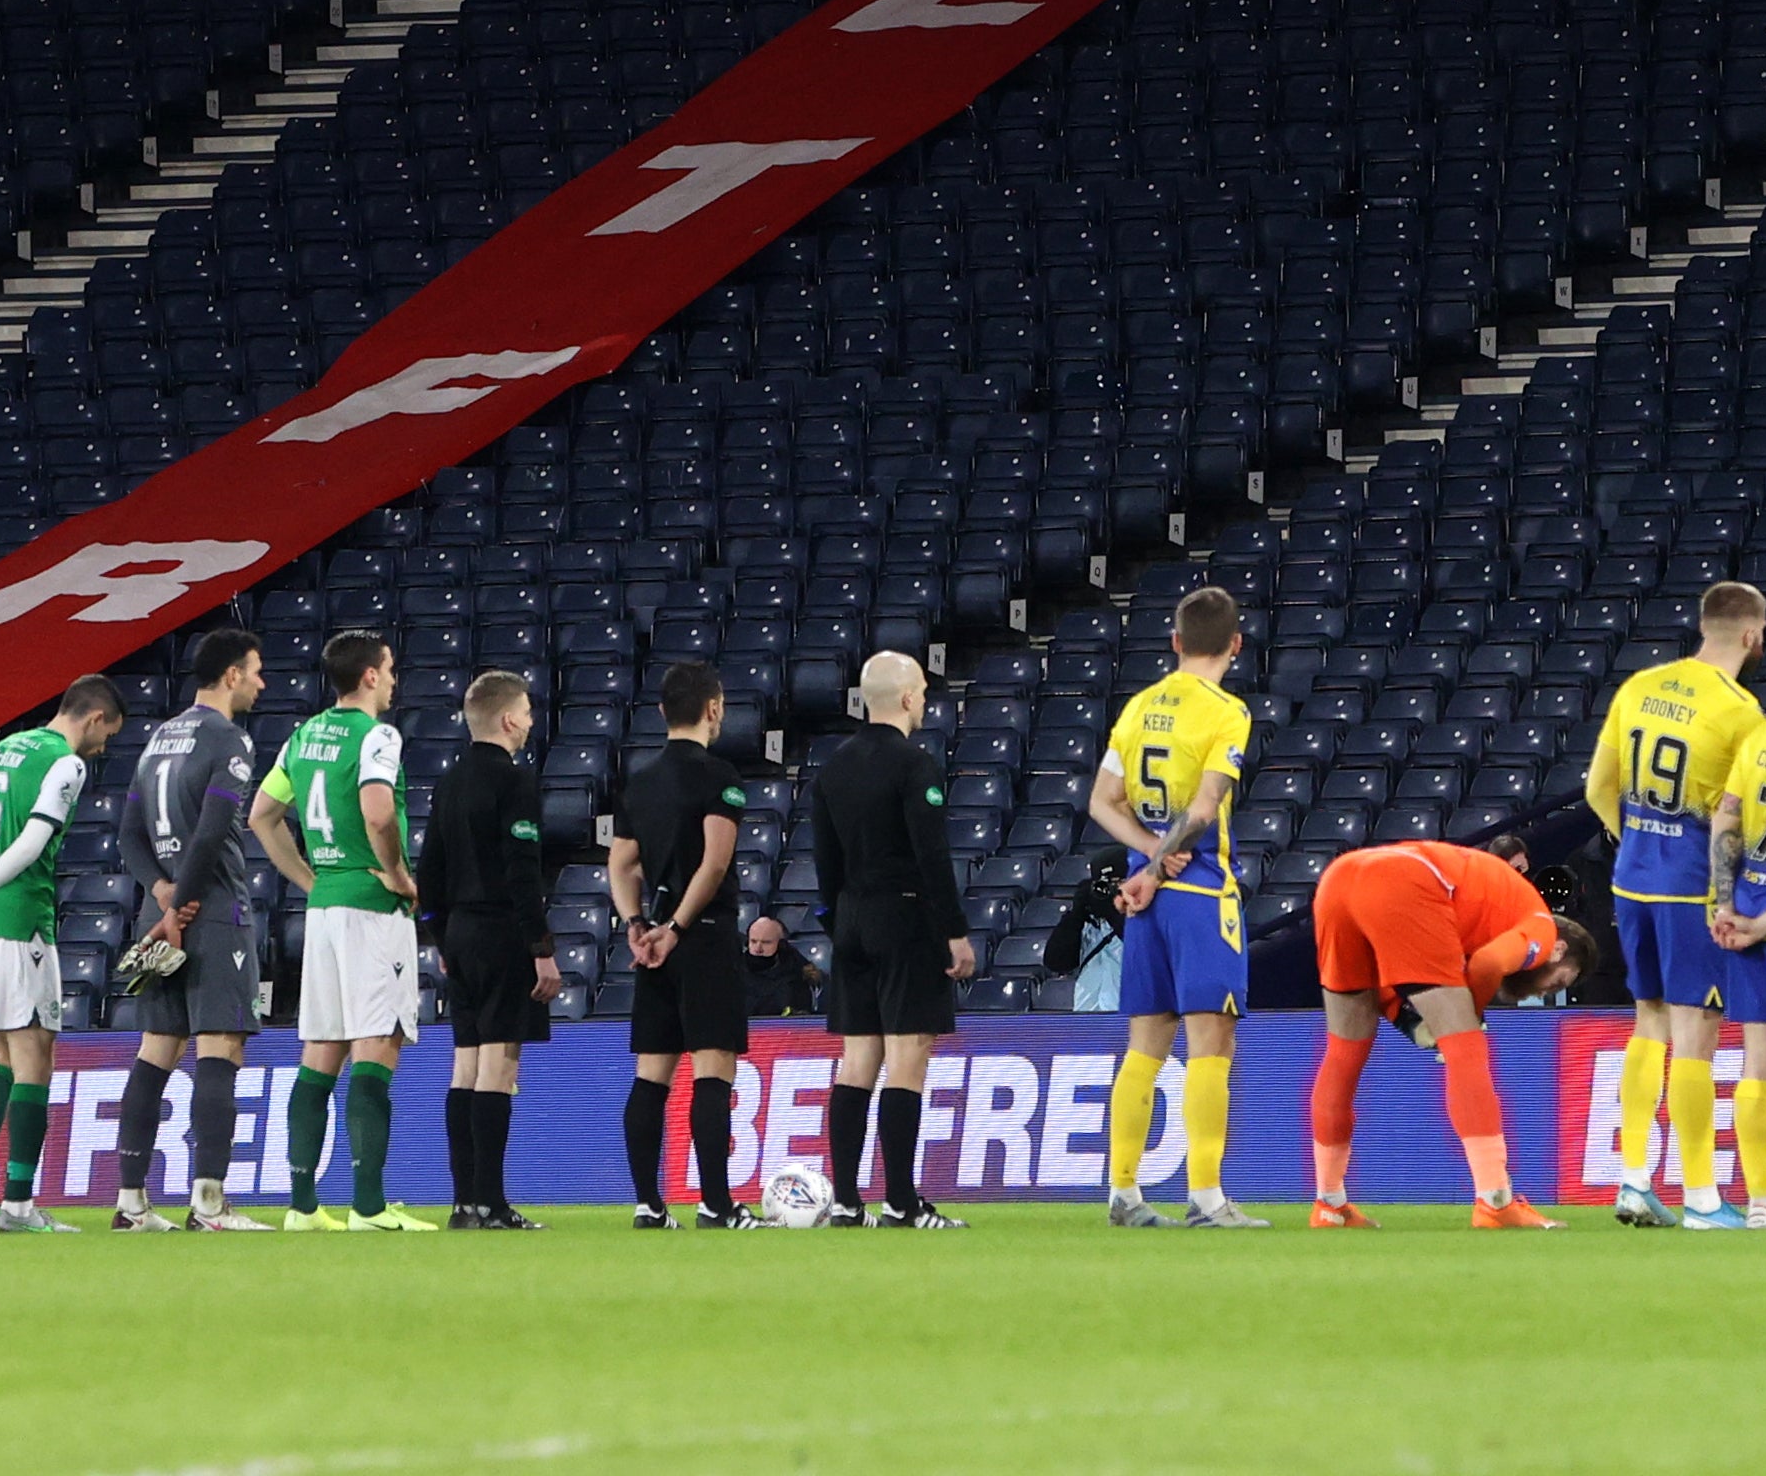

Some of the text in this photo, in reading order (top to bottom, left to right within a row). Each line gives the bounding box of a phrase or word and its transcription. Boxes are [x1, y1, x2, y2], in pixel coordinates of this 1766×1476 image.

[1142, 712, 1176, 733] KERR
[1640, 696, 1698, 725] ROONEY
[154, 758, 172, 837] 1
[305, 769, 334, 844] 4
[1140, 745, 1171, 823] 5
[1629, 728, 1689, 816] 19
